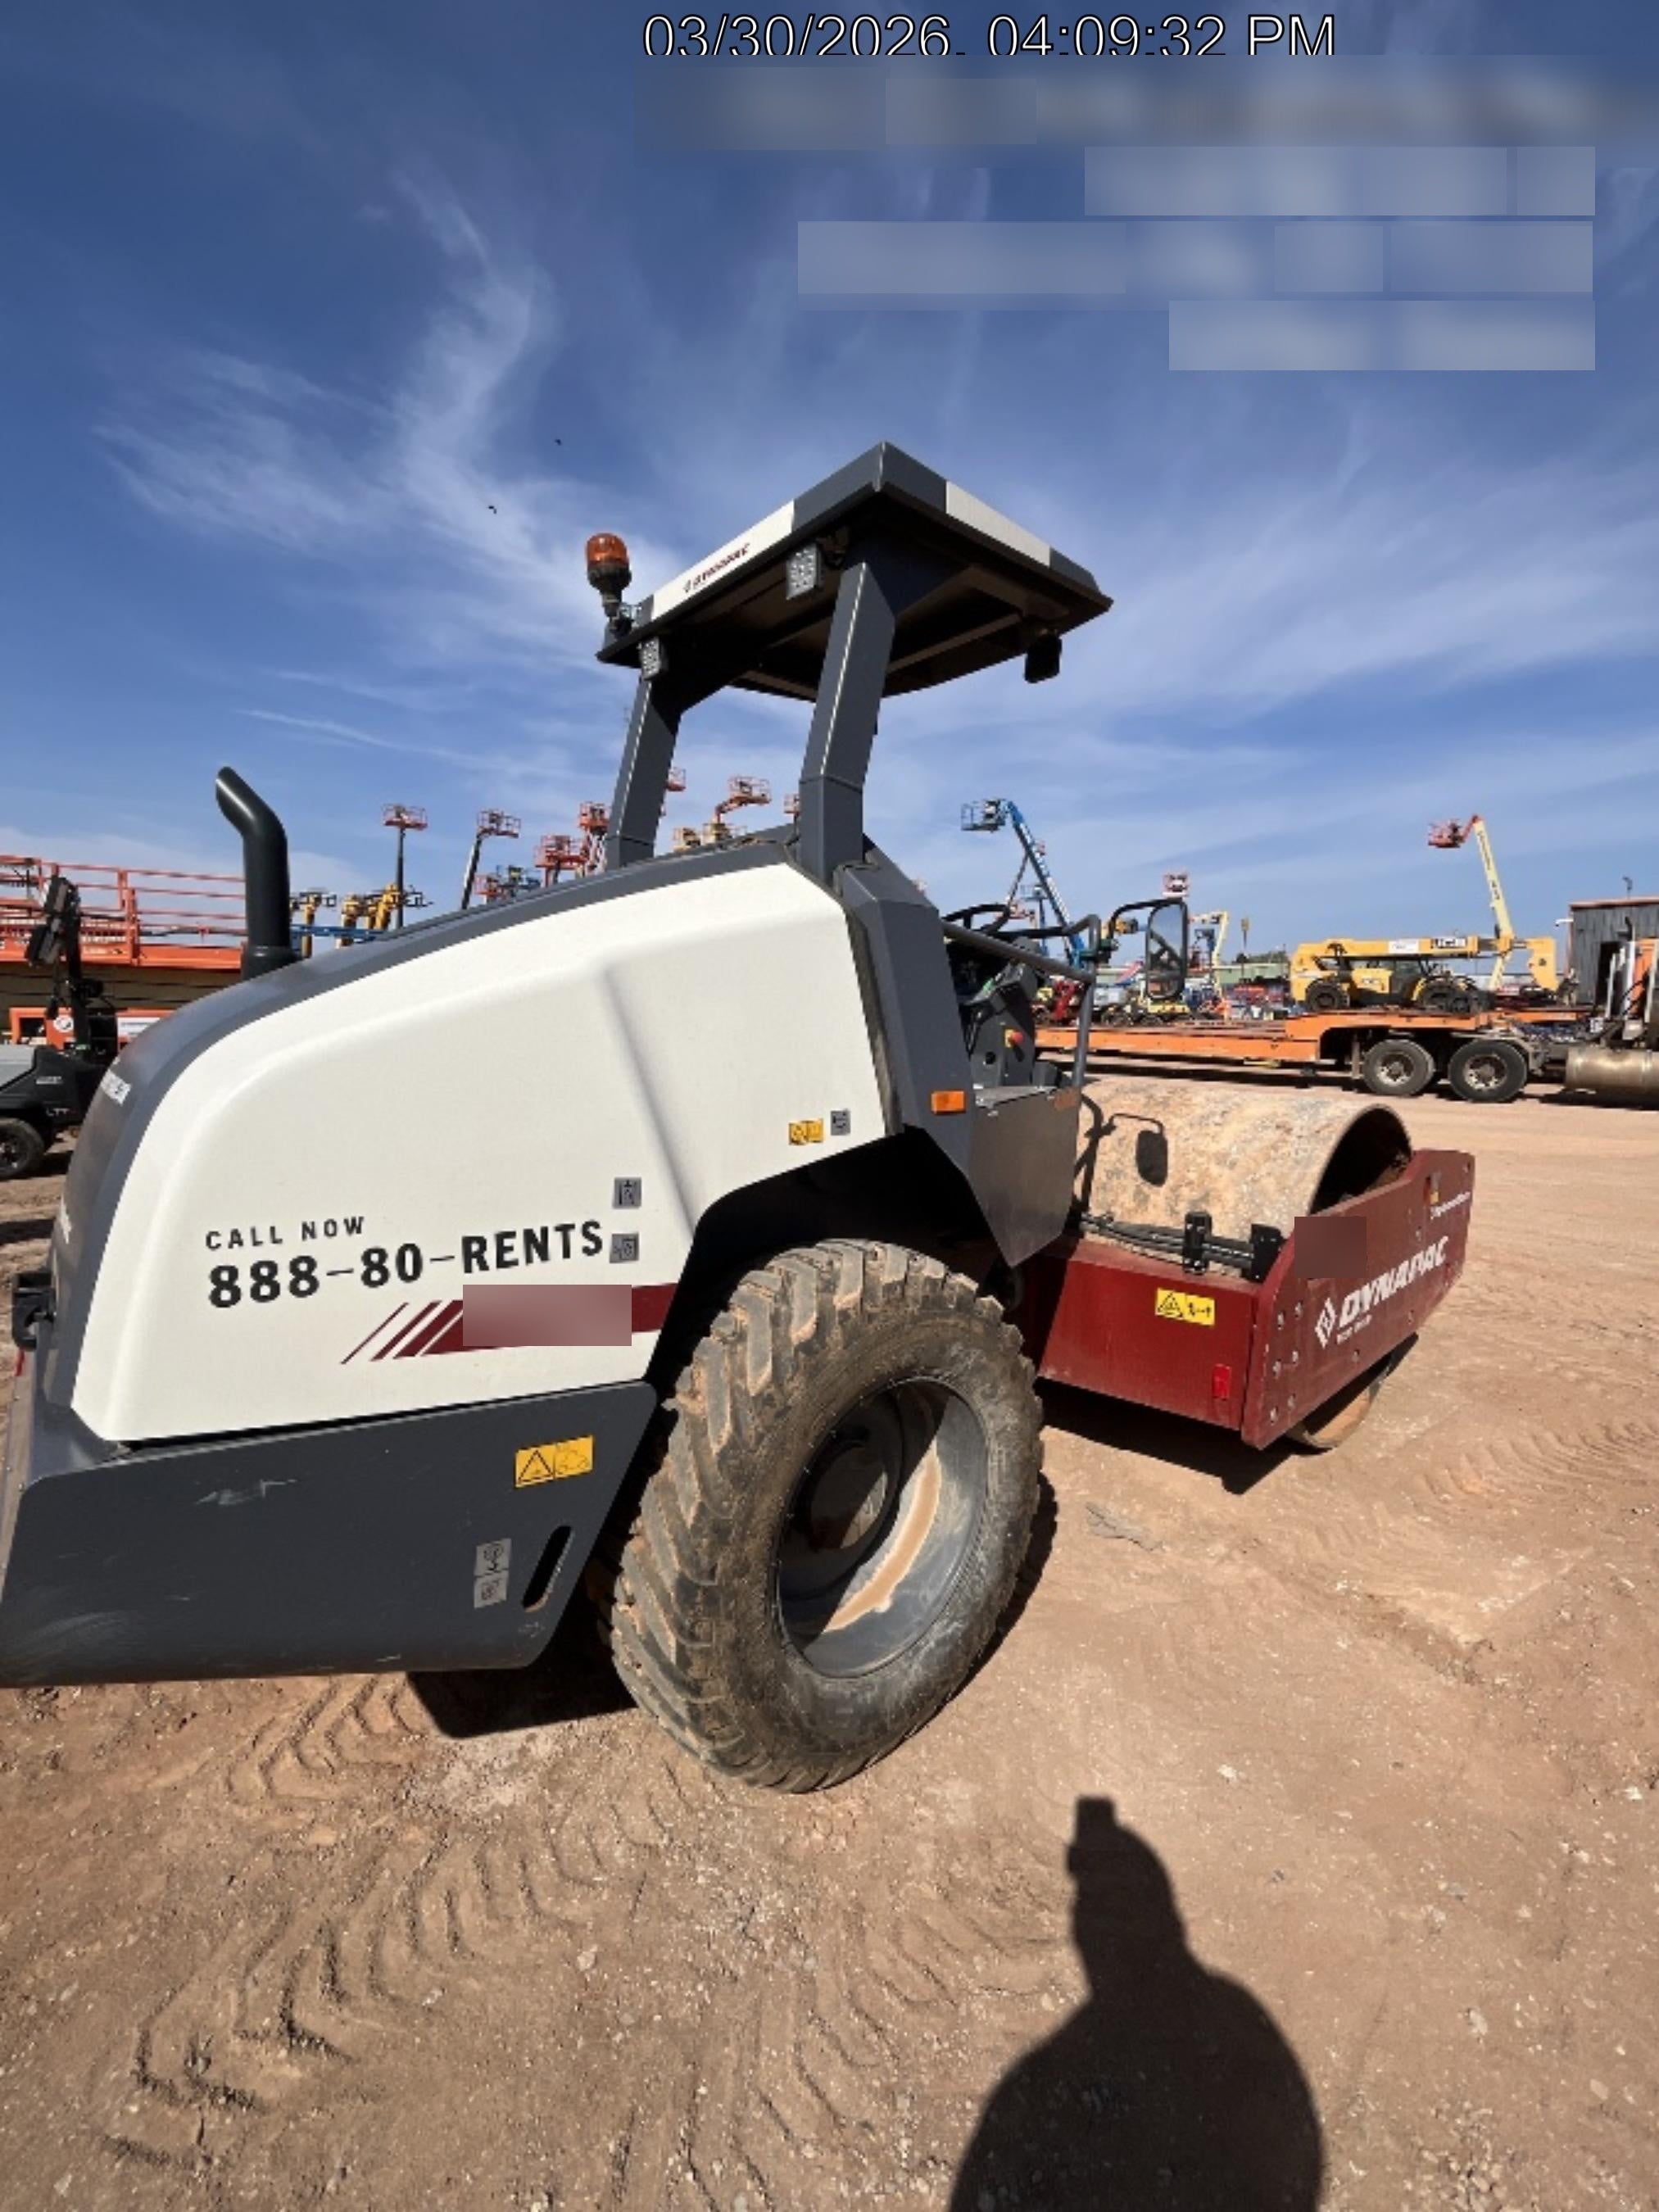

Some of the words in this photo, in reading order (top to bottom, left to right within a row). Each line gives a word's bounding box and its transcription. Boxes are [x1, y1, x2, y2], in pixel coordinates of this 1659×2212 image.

[205, 1226, 283, 1251] CALL
[301, 1216, 364, 1241] NOW
[208, 1219, 603, 1308] 888-80-RENTS
